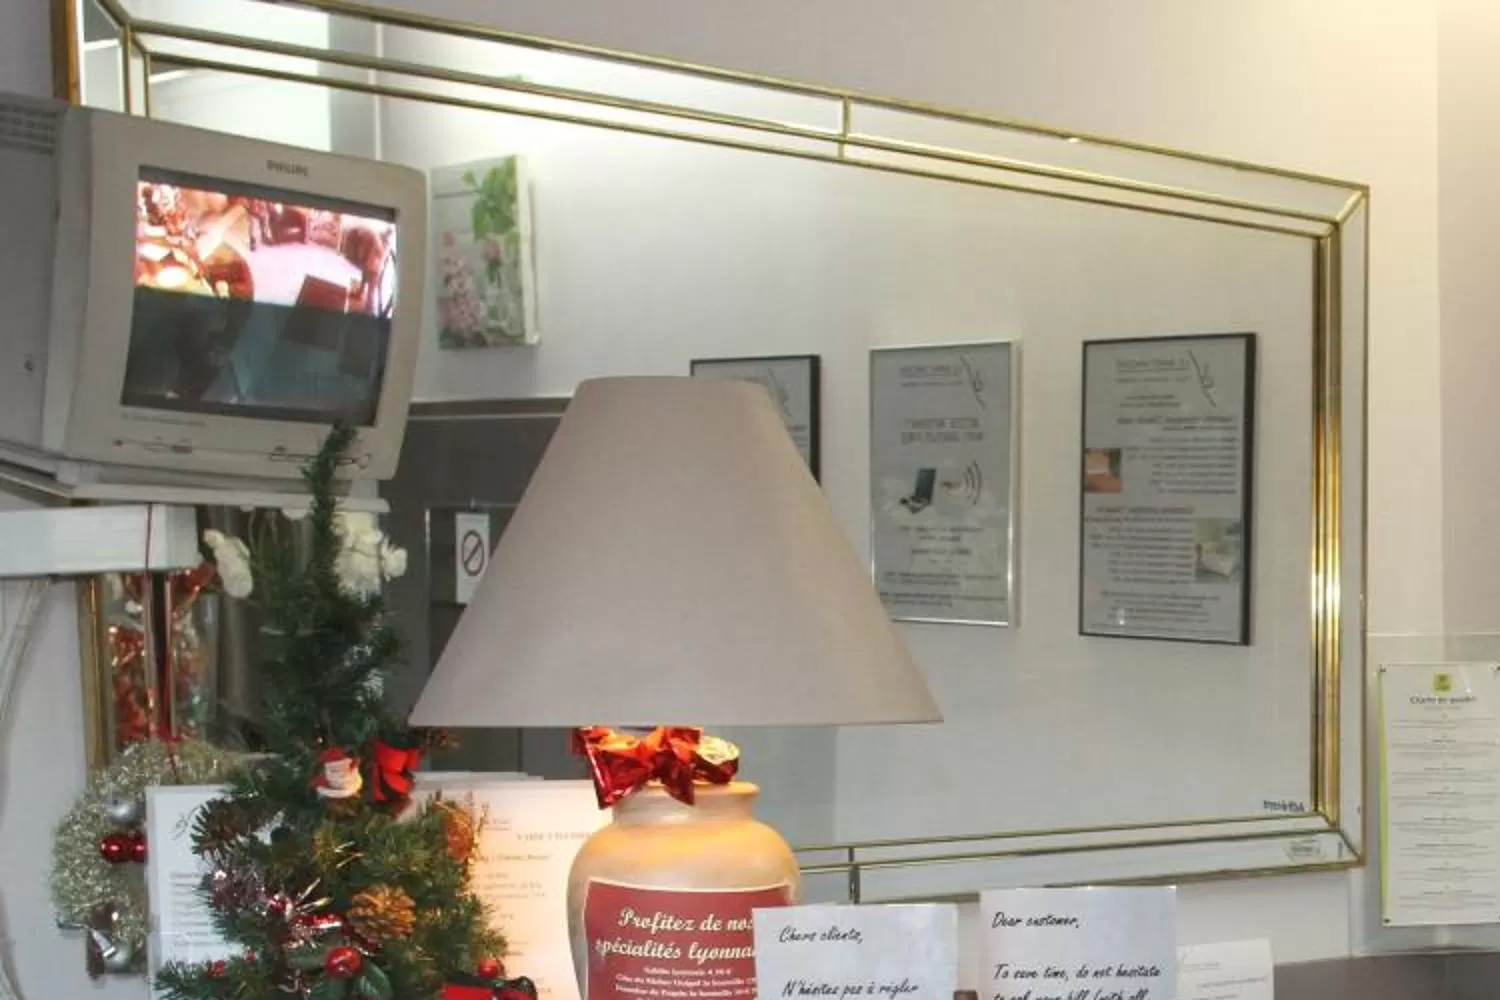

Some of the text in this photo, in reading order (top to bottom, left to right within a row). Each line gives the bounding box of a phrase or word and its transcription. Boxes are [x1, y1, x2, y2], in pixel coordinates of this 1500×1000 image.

[618, 908, 697, 934] Profitez
[700, 913, 721, 931] de
[992, 911, 1080, 930] Dear customer,
[779, 925, 863, 944] Chers clients,
[595, 936, 756, 965] spécialités lyonna
[993, 963, 1009, 980] To
[1013, 967, 1038, 979] save
[1043, 966, 1069, 982] time,
[1075, 964, 1089, 979] do
[1092, 966, 1113, 979] not
